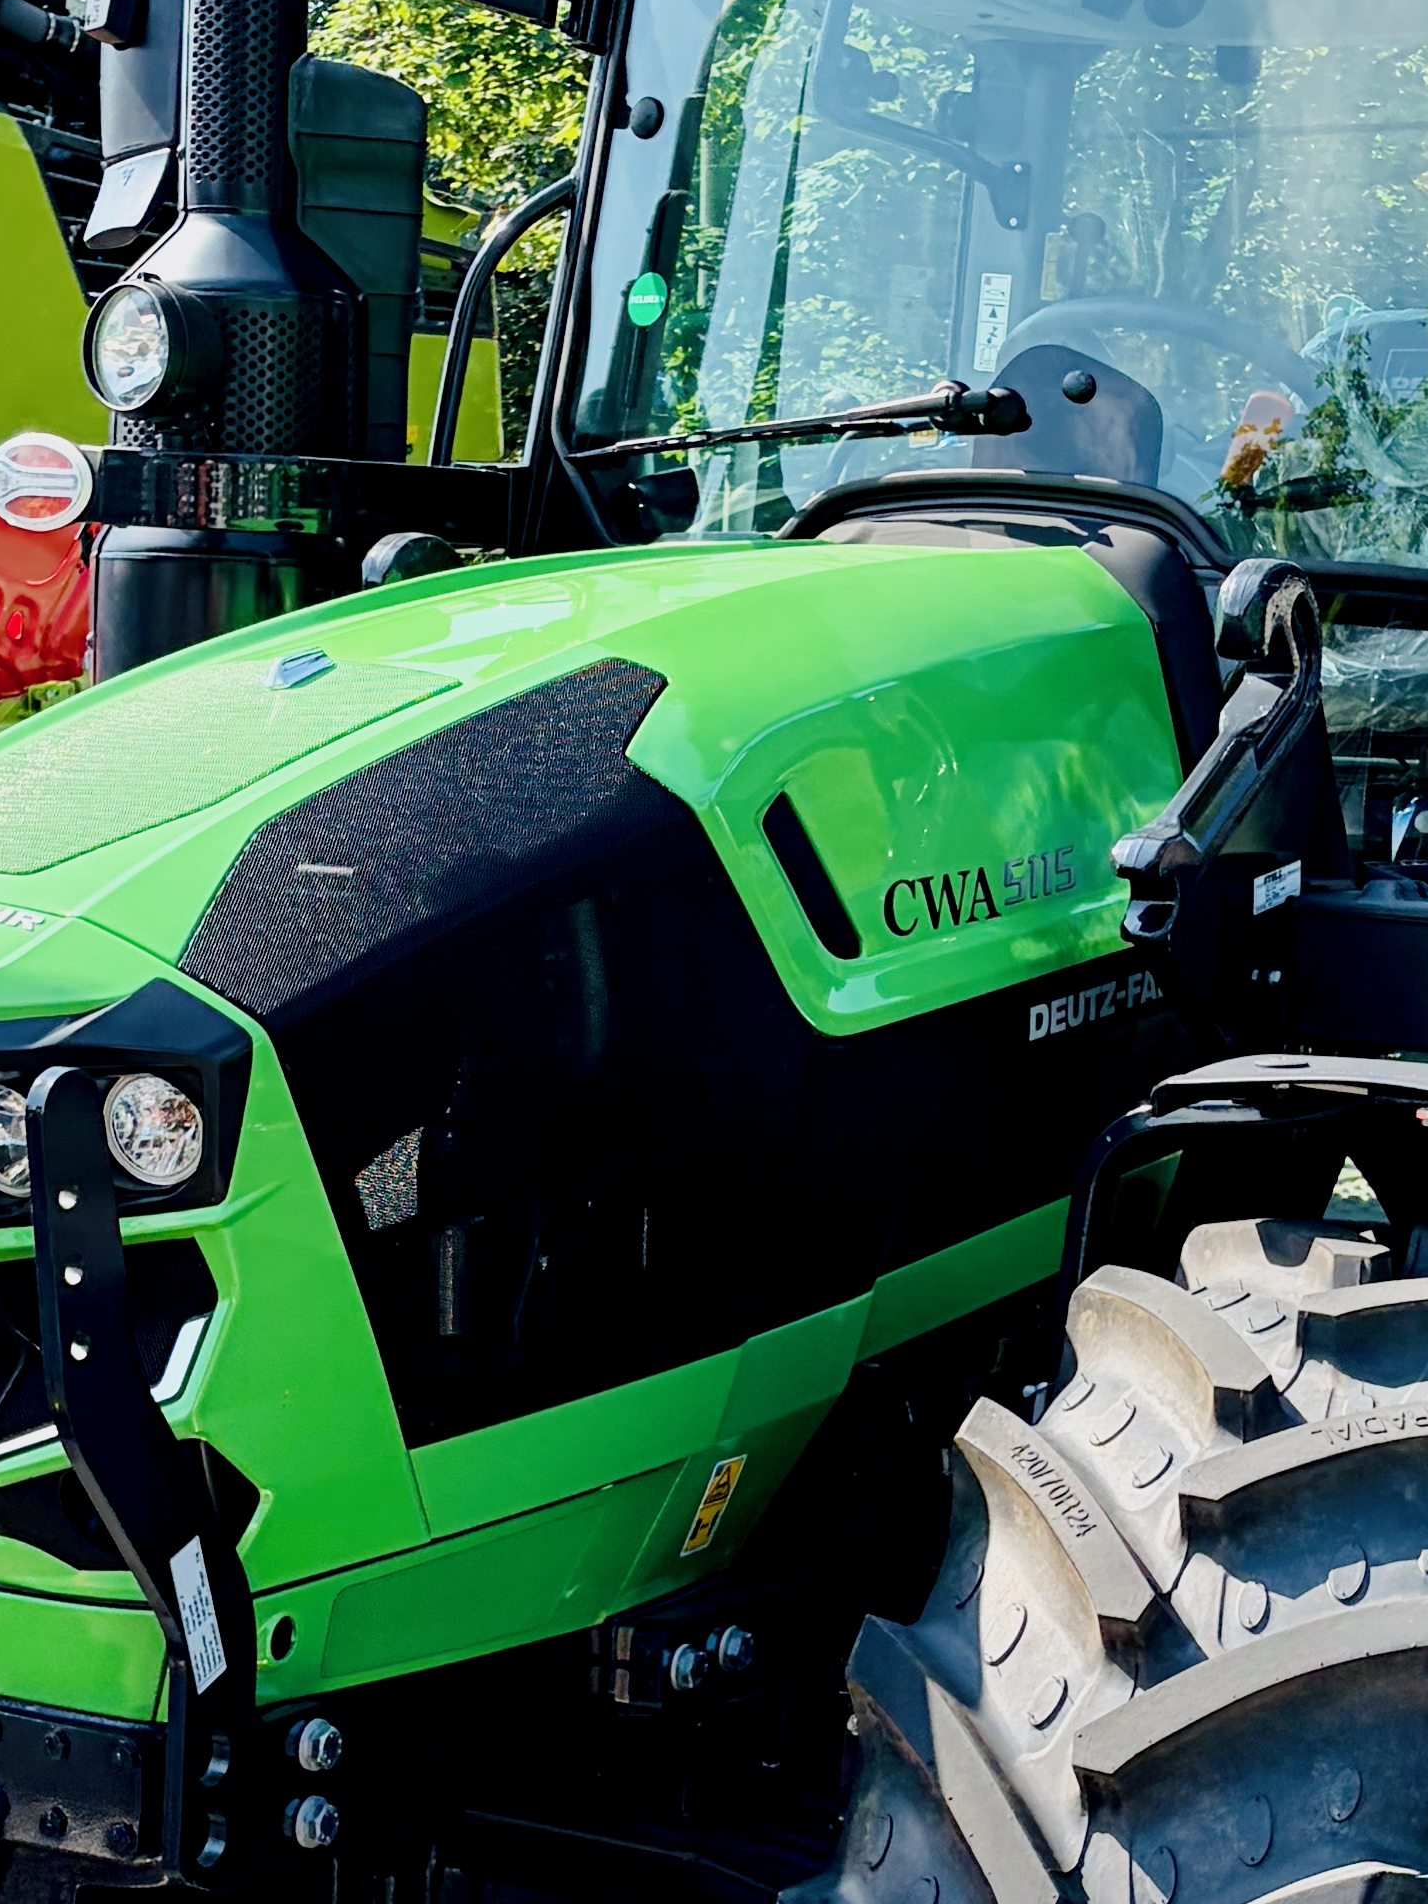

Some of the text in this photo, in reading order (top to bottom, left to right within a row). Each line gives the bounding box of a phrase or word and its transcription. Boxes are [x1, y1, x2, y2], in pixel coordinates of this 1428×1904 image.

[884, 844, 1077, 936] CWA 5115
[1029, 970, 1164, 1042] DEUTZ-FA
